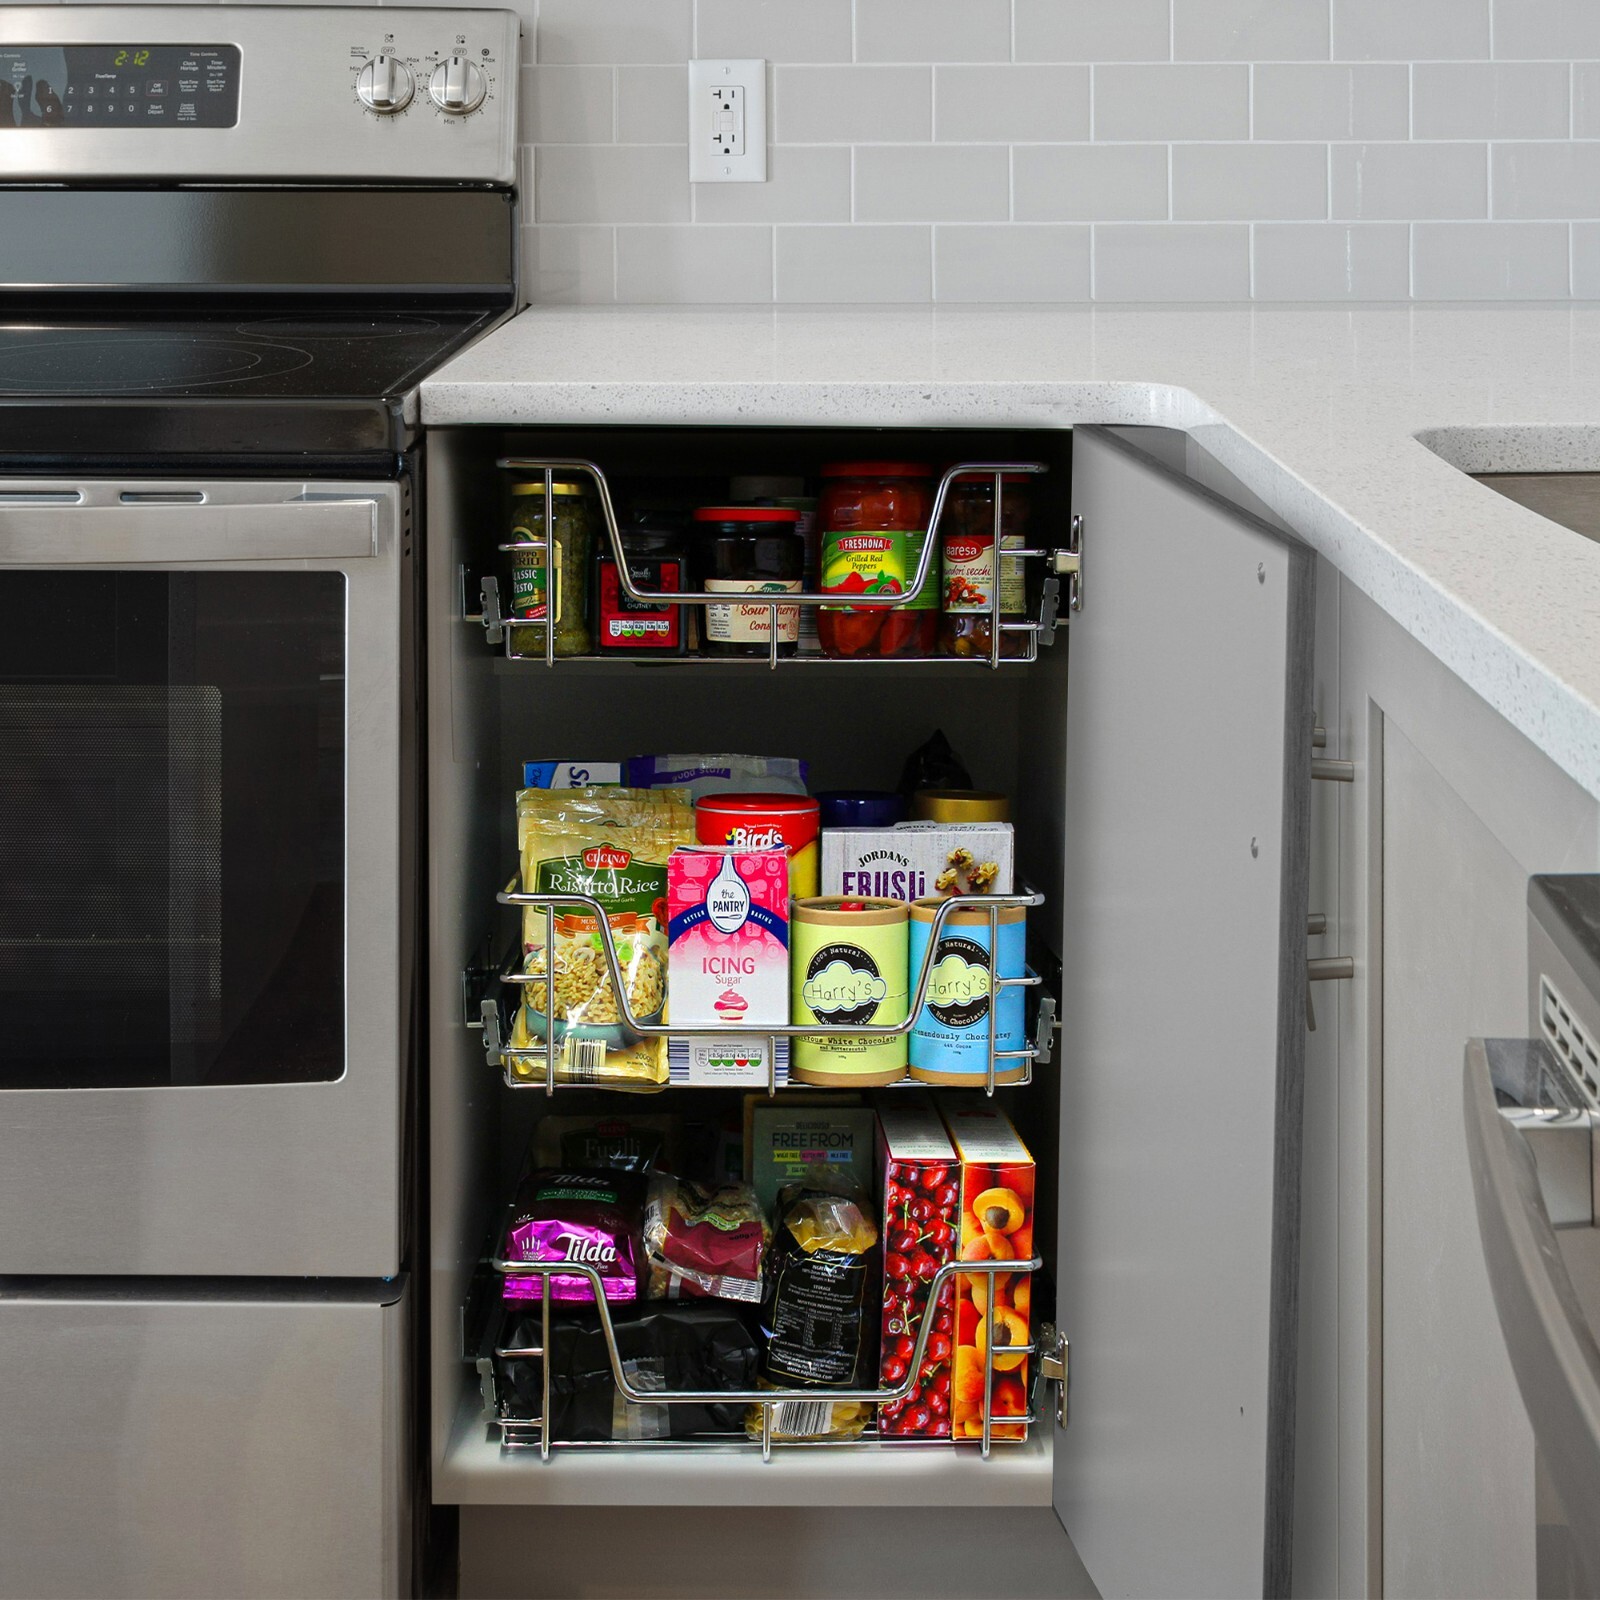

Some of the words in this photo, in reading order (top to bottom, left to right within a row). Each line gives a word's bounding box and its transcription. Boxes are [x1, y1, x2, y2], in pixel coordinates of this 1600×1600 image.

[115, 50, 149, 66] 2:12
[68, 86, 74, 94] 2
[88, 86, 94, 94] 3
[109, 86, 115, 94] 4
[129, 86, 135, 94] 5
[46, 105, 52, 113] 6
[107, 104, 114, 112] 9
[128, 104, 134, 112] 0
[844, 538, 884, 550] FRESHONA
[846, 554, 869, 562] Grilled
[869, 554, 883, 562] Red
[851, 562, 877, 571] Peppers
[966, 564, 992, 576] secchi
[514, 582, 533, 594] PESTO
[627, 602, 652, 610] CHUTNEY
[741, 603, 769, 616] Sour
[776, 603, 799, 618] herry
[734, 828, 783, 850] Bird's
[586, 852, 627, 864] CUCINA
[858, 849, 910, 868] JORDANS
[549, 873, 615, 894] Risotto
[619, 877, 659, 894] Rice
[721, 889, 735, 898] the
[712, 900, 745, 912] PANTRY
[683, 910, 705, 924] BETTER
[751, 910, 773, 925] BAKING
[829, 946, 861, 958] Natural
[945, 941, 976, 952] Natural
[702, 957, 755, 974] ICING
[715, 974, 742, 987] Sugar
[927, 974, 987, 995] Harry's
[811, 980, 873, 1002] Harry's
[935, 1010, 947, 1022] Hot
[950, 1010, 985, 1025] Chocolate
[828, 1037, 853, 1045] White
[858, 1036, 897, 1045] Chocolate
[556, 1232, 616, 1263] Tilda
